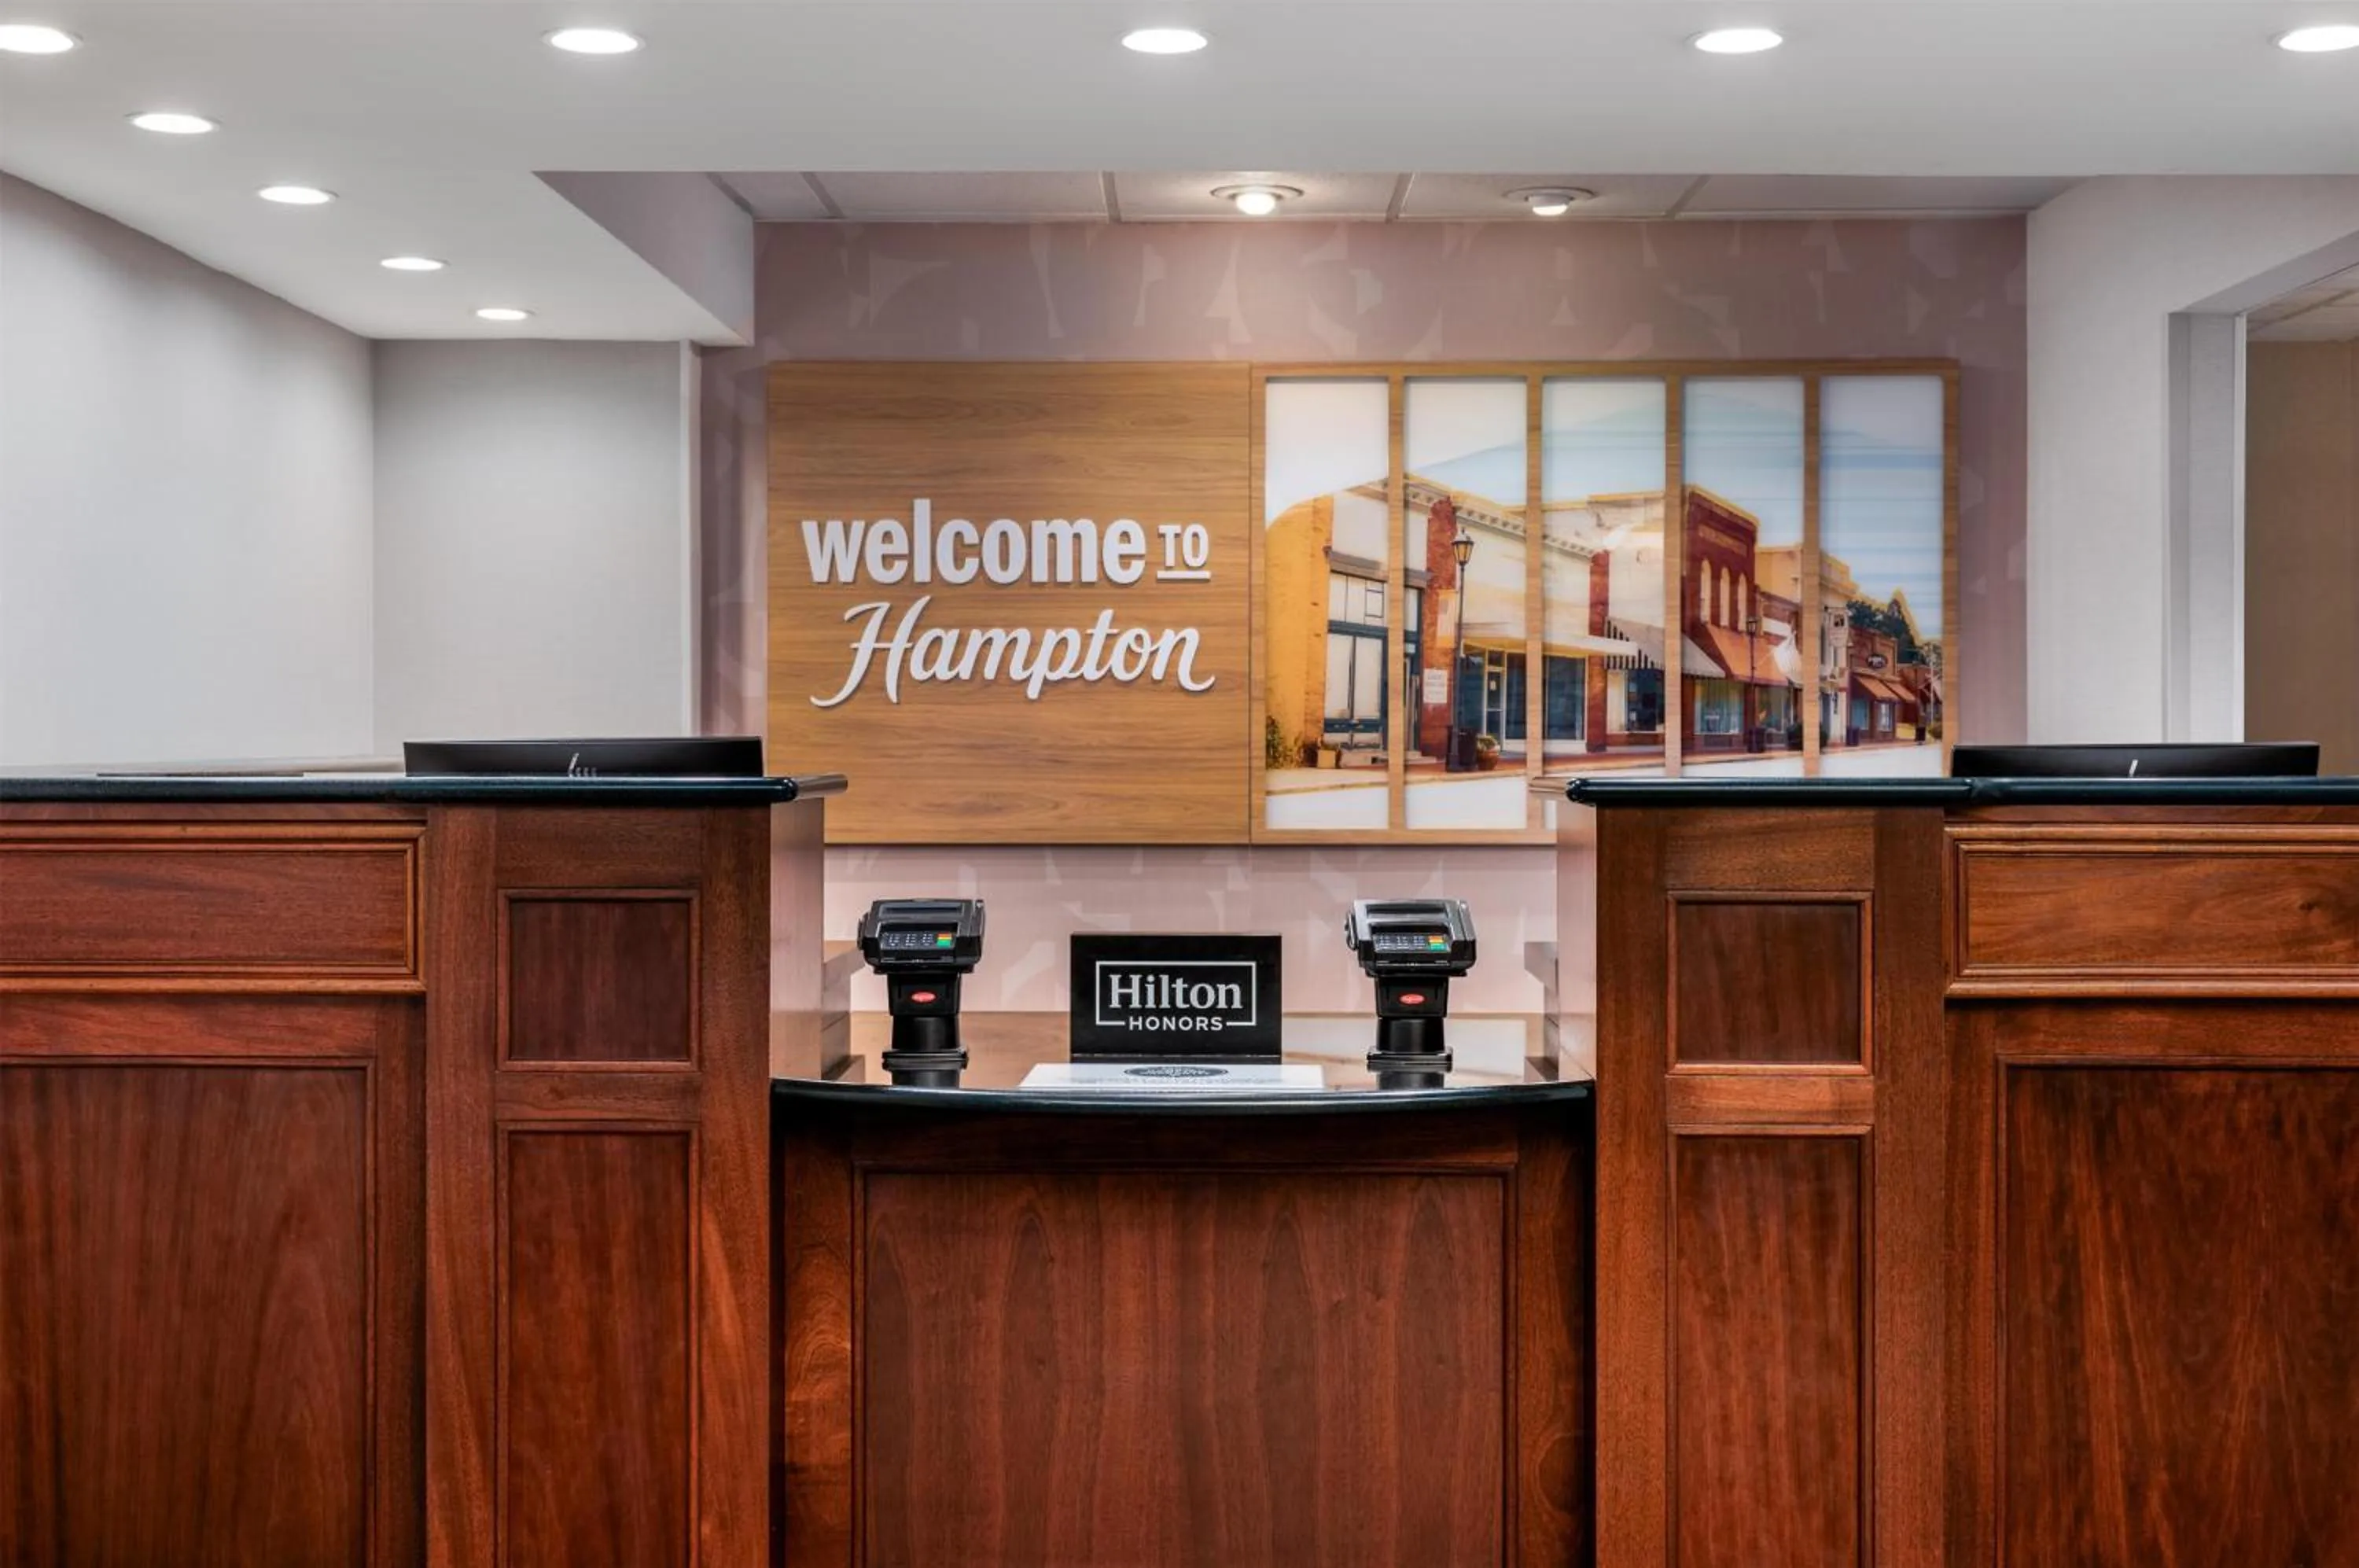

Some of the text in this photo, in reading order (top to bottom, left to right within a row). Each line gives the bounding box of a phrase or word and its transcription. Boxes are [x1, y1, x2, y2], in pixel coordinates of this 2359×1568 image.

[801, 498, 1210, 583] welcome TO
[810, 595, 1216, 707] Hampton
[1108, 974, 1243, 1009] Hilton
[1129, 1017, 1224, 1031] HONORS
